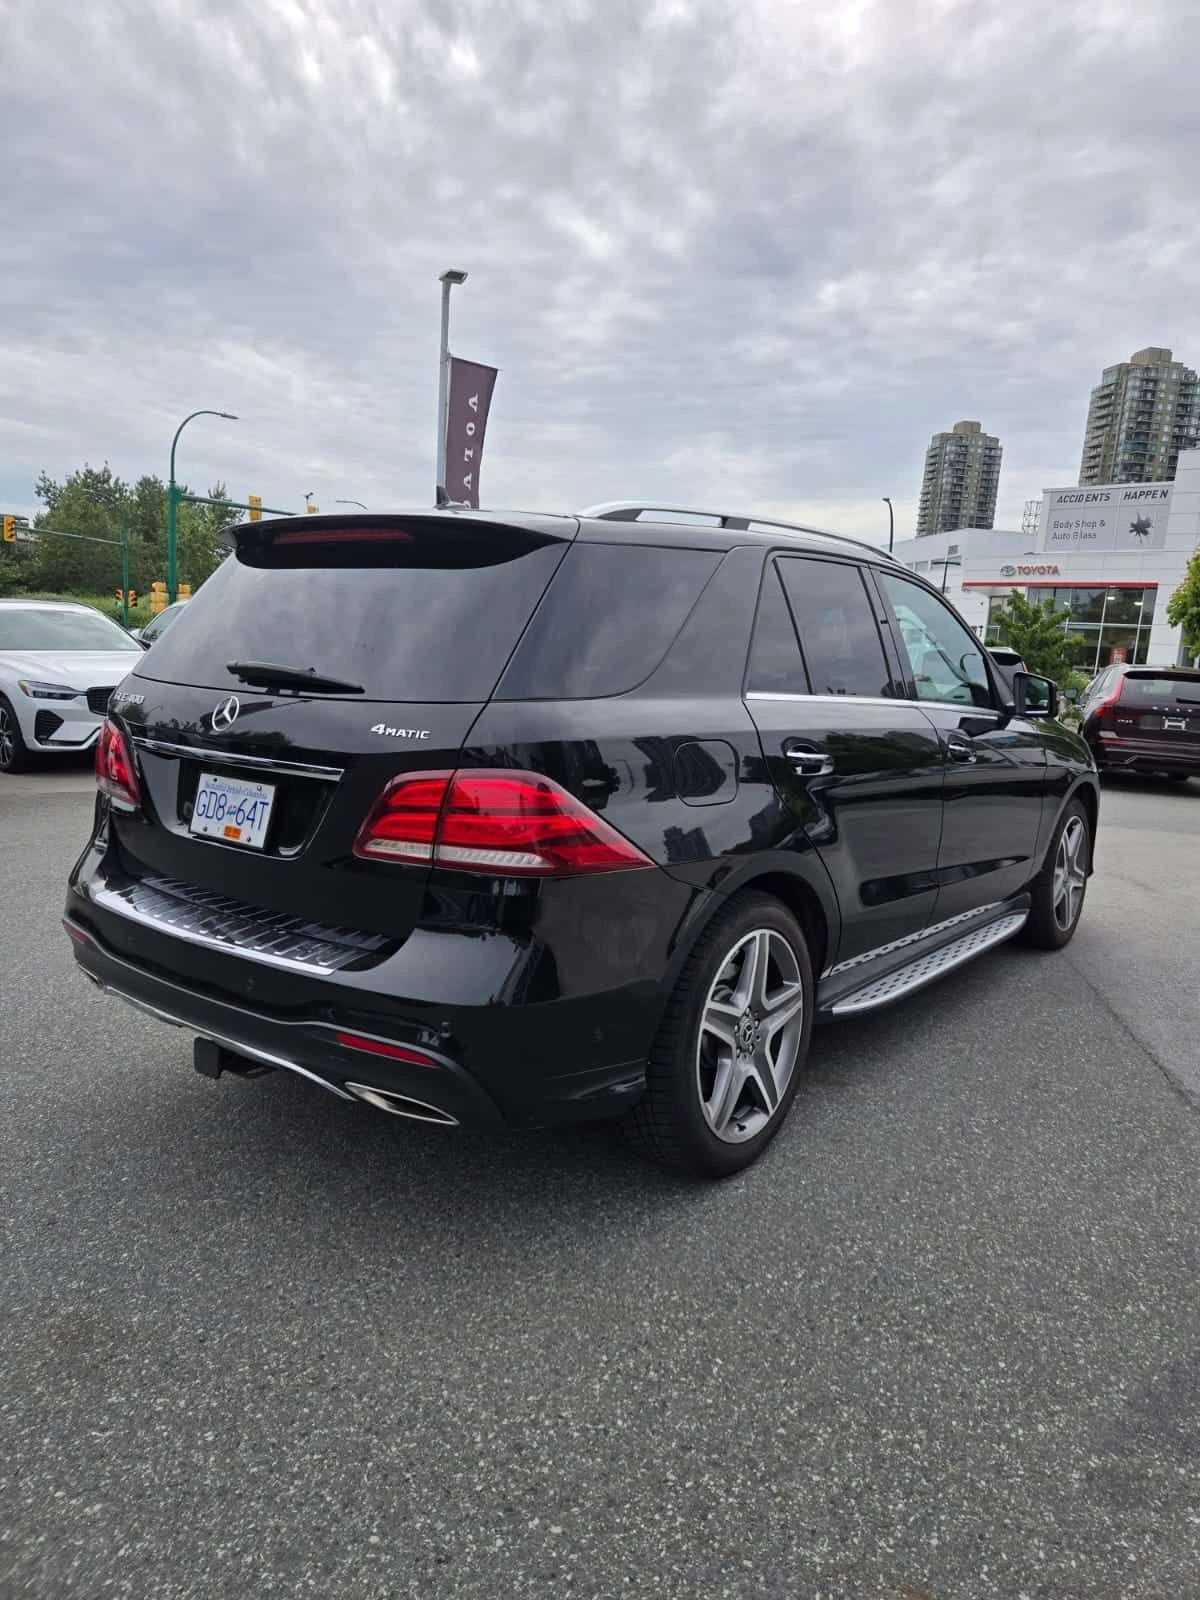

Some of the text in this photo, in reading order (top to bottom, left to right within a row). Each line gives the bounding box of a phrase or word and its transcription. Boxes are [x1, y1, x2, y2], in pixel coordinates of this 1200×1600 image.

[1057, 489, 1169, 504] ACCIDENTS HAPPEN
[1053, 519, 1106, 530] Body Shop &
[1052, 531, 1097, 541] Auto Glass
[1016, 565, 1060, 576] TOYOTA
[370, 723, 431, 740] 4MATIC
[196, 790, 270, 831] GD8 64T
